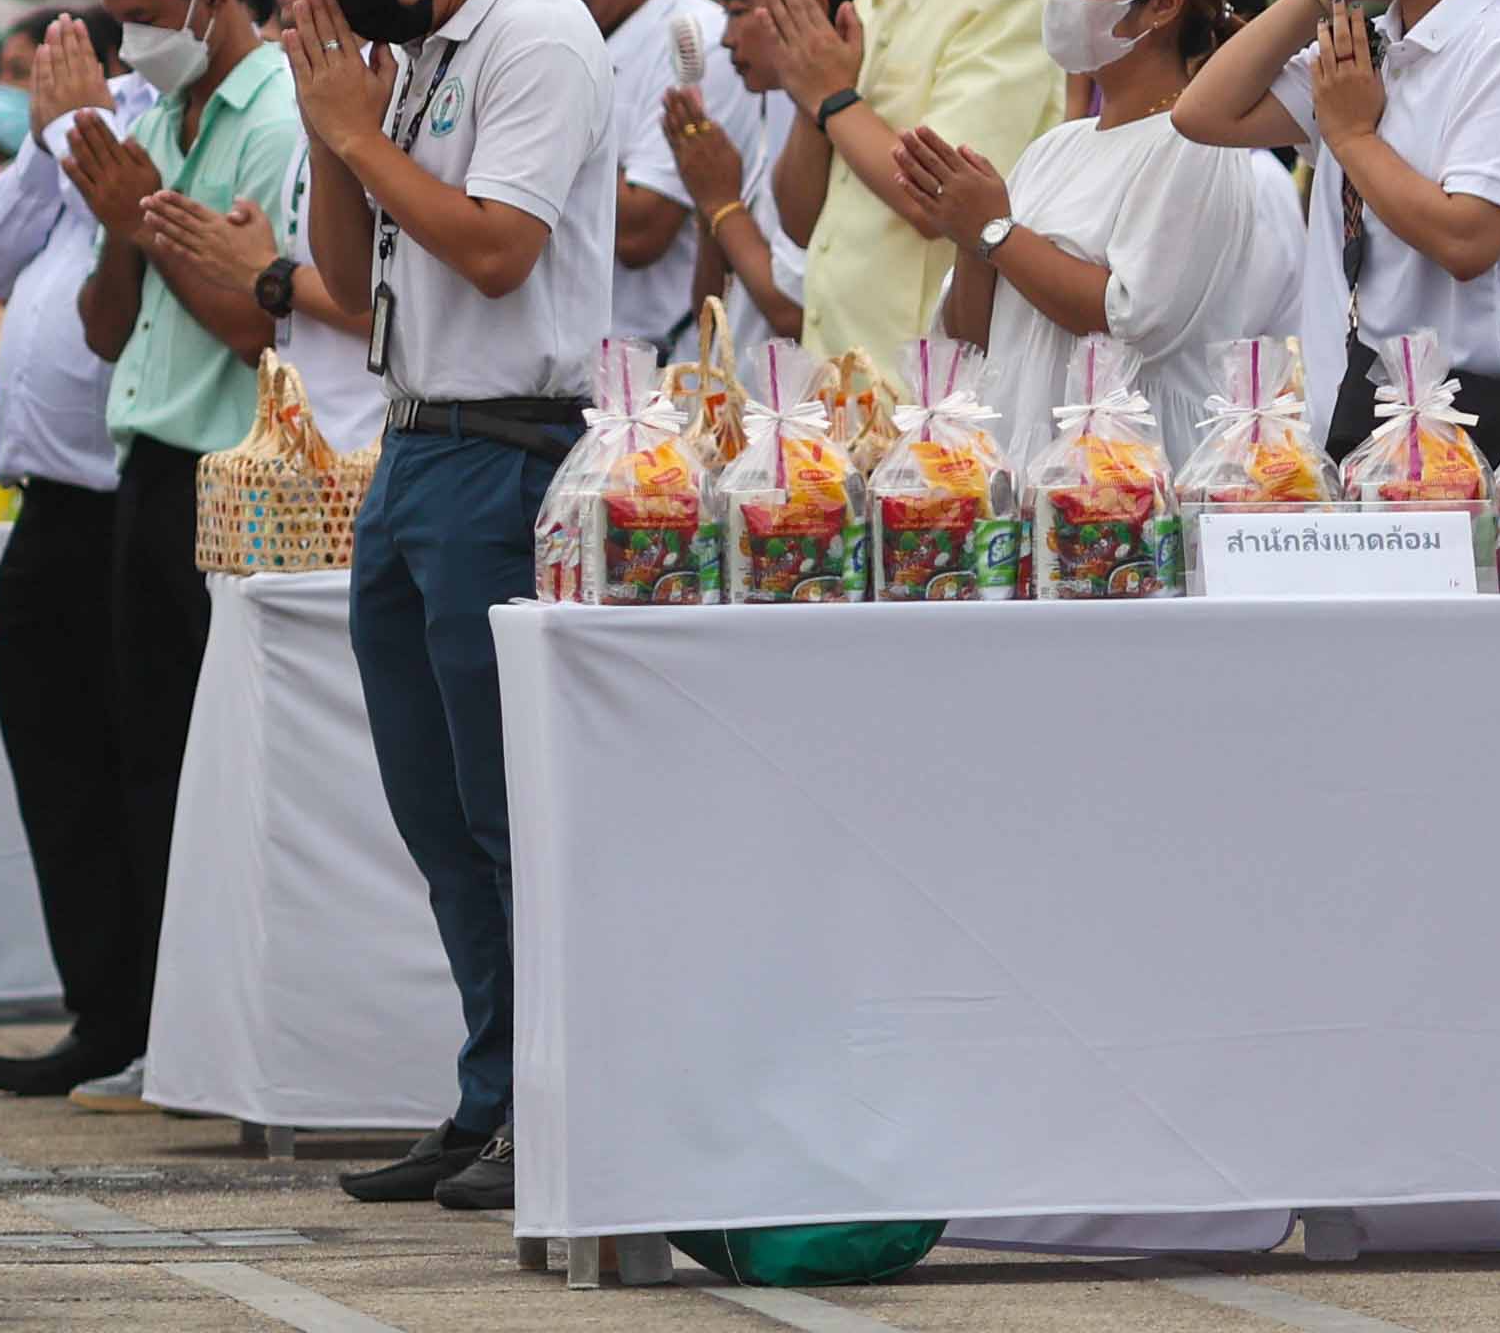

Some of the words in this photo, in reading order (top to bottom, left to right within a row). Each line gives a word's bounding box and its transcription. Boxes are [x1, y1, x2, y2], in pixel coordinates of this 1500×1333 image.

[1227, 521, 1441, 552] สำนักสิ่งแวดล้อม
